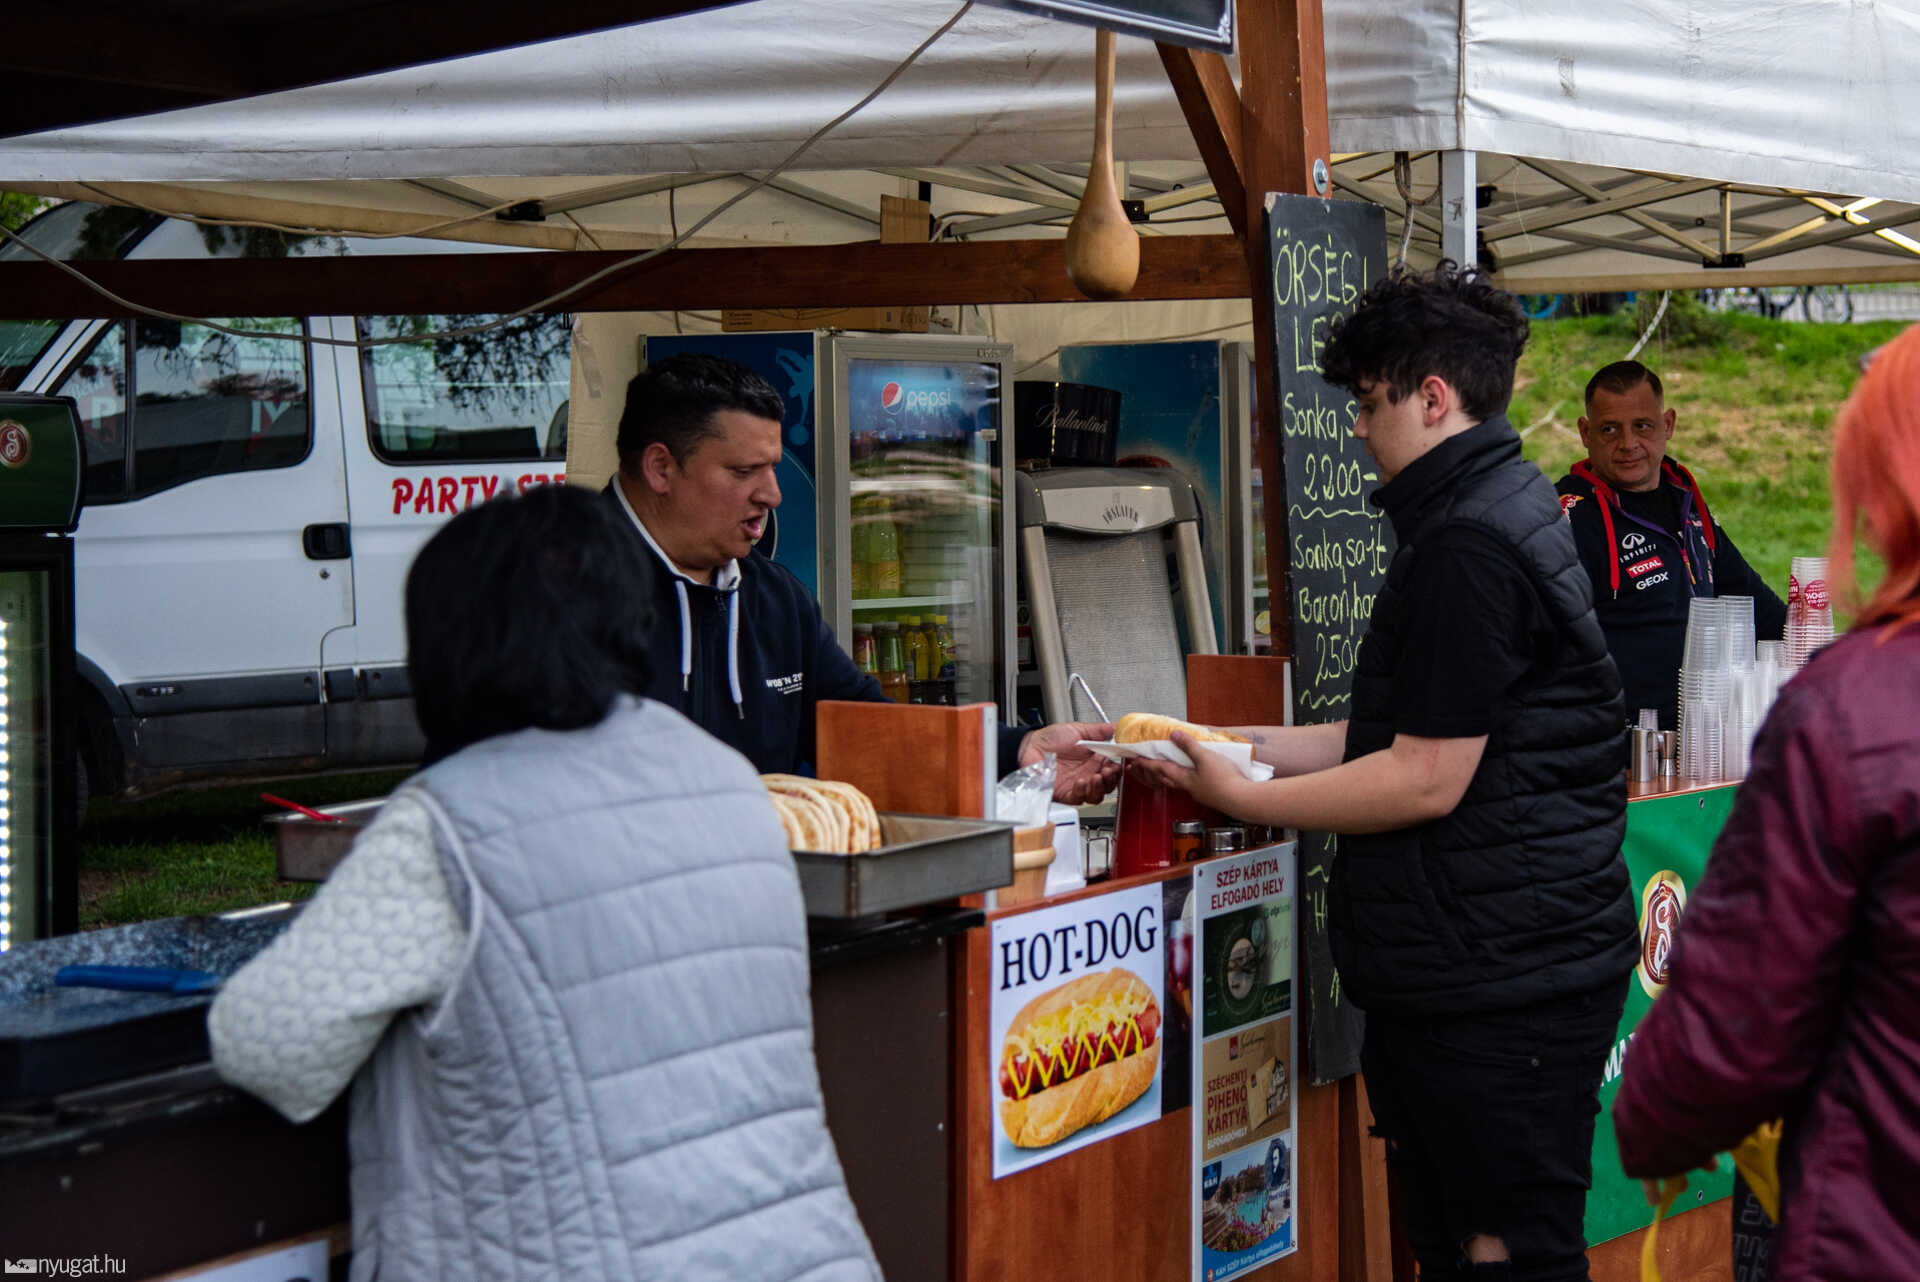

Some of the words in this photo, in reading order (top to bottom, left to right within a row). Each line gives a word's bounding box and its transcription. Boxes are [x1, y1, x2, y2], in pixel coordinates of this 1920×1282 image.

[906, 387, 951, 408] pepsi
[1619, 543, 1657, 564] INFINITI
[1629, 560, 1662, 576] TOTAL
[1635, 571, 1670, 590] GEOX
[1216, 865, 1242, 888] SZÉP
[1243, 858, 1279, 882] KÁRTYA
[1211, 881, 1260, 910] ELFOGADÓ
[1262, 877, 1285, 897] HELY
[1000, 906, 1157, 991] HOT-DOG
